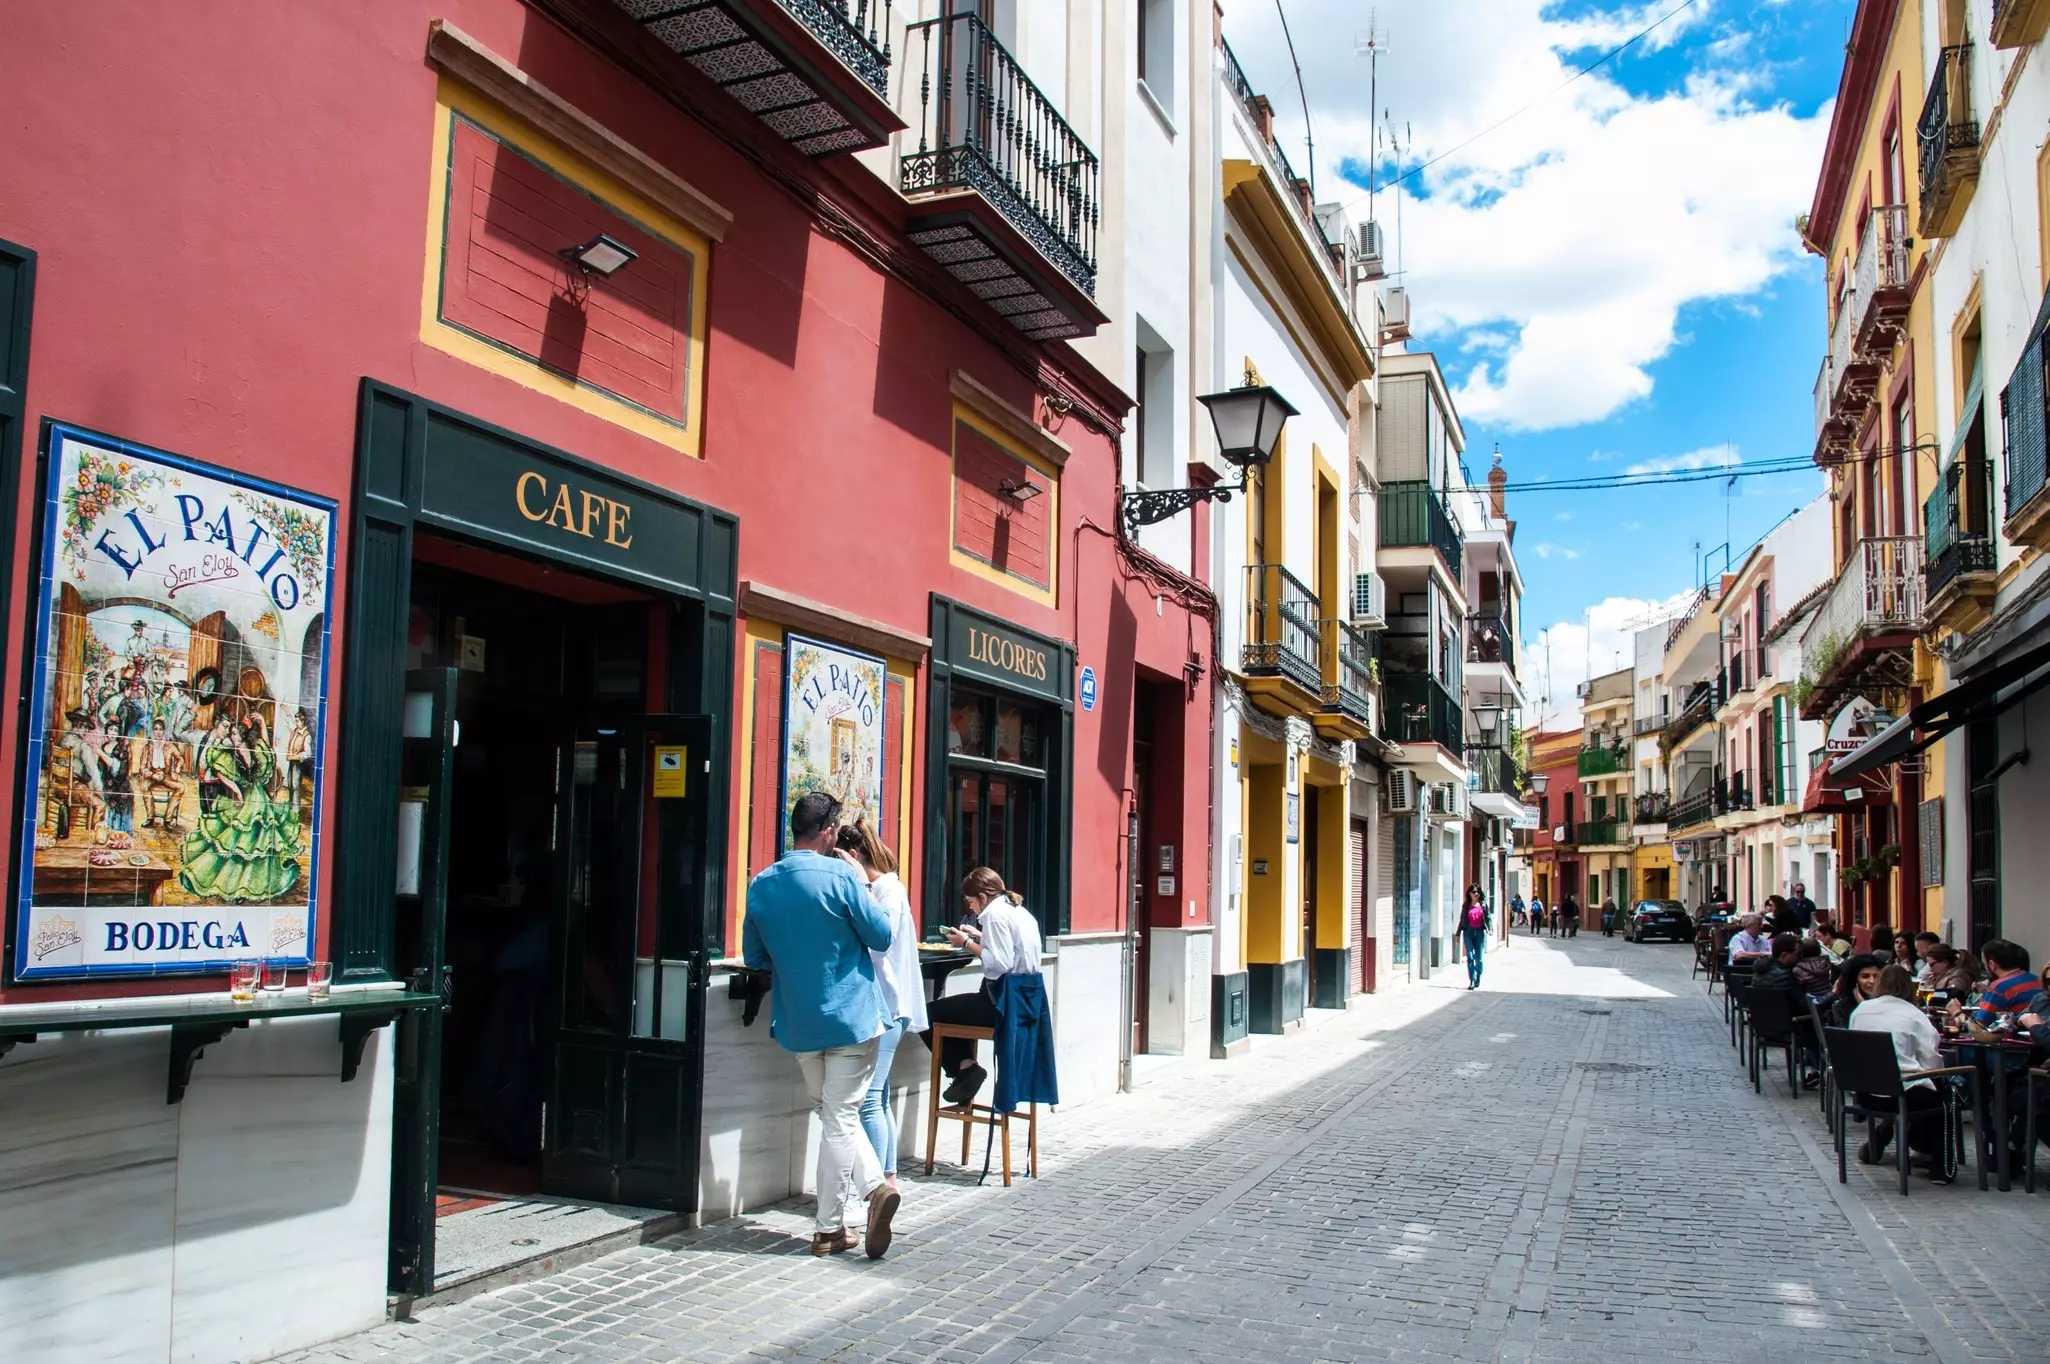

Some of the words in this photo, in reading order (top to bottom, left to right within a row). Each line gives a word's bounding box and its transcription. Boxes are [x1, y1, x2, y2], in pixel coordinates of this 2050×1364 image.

[516, 471, 633, 550] CAFE
[94, 507, 167, 581] EL
[174, 494, 299, 611] PATIO
[163, 563, 197, 589] San
[202, 554, 239, 578] Eloy
[968, 627, 1046, 681] LICORES
[803, 675, 827, 714] EL
[829, 664, 873, 727] PATIO
[104, 920, 251, 952] BODEGA
